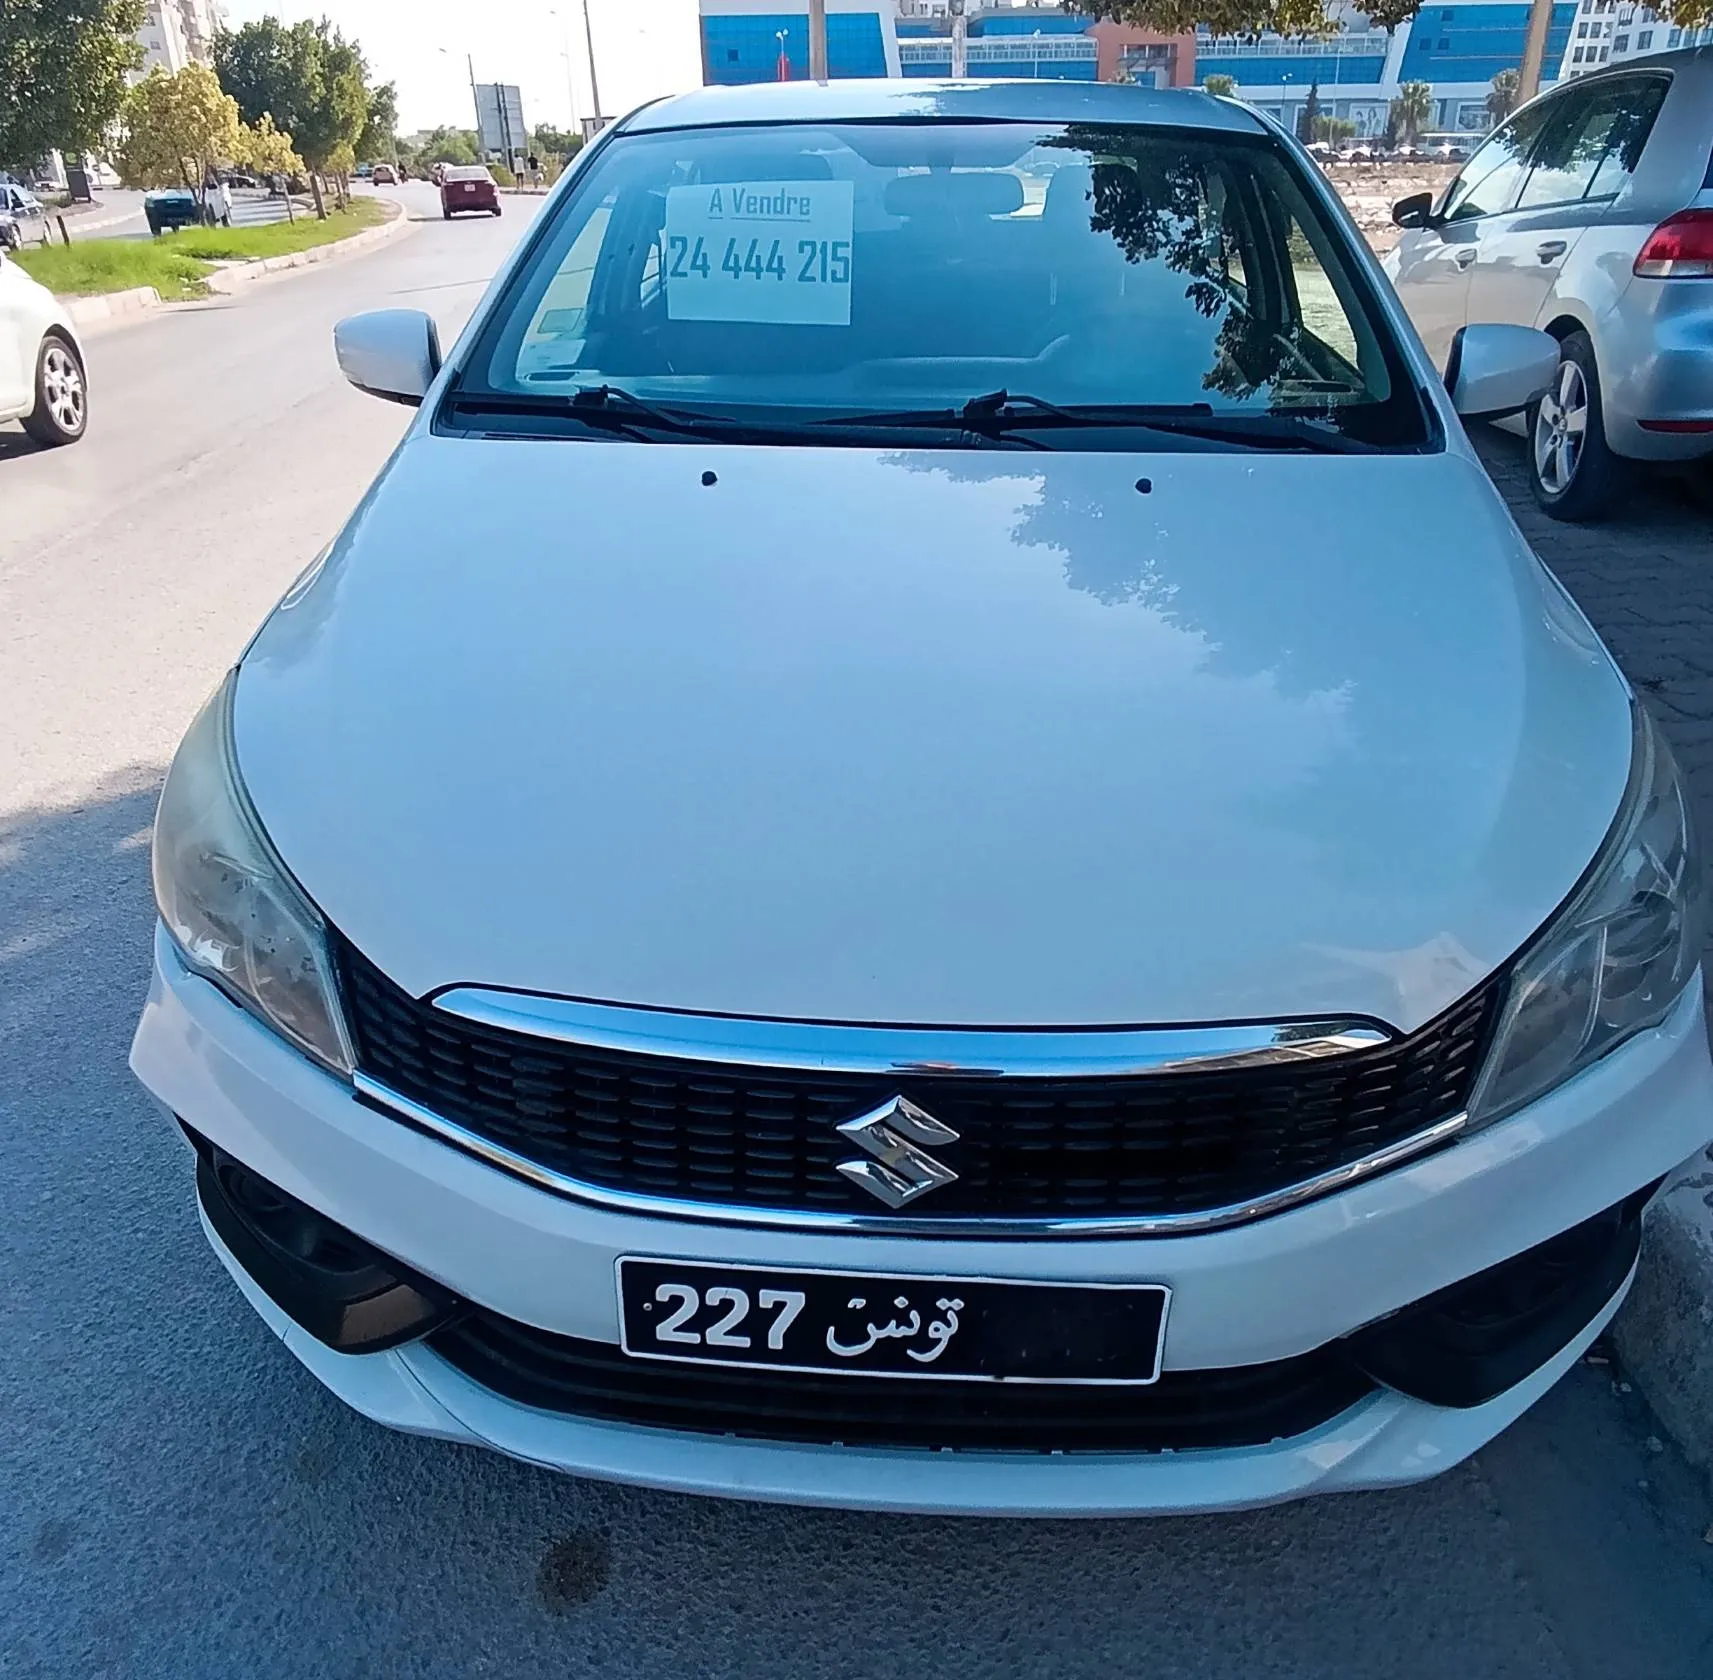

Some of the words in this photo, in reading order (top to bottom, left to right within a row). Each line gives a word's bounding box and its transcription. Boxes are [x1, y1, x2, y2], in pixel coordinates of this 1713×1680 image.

[709, 187, 723, 213] A
[732, 187, 811, 216] Vendre
[669, 235, 711, 279] 24
[721, 237, 786, 281] 444
[797, 239, 850, 284] 215
[655, 1283, 806, 1350] 227
[826, 1296, 965, 1363] تونس
